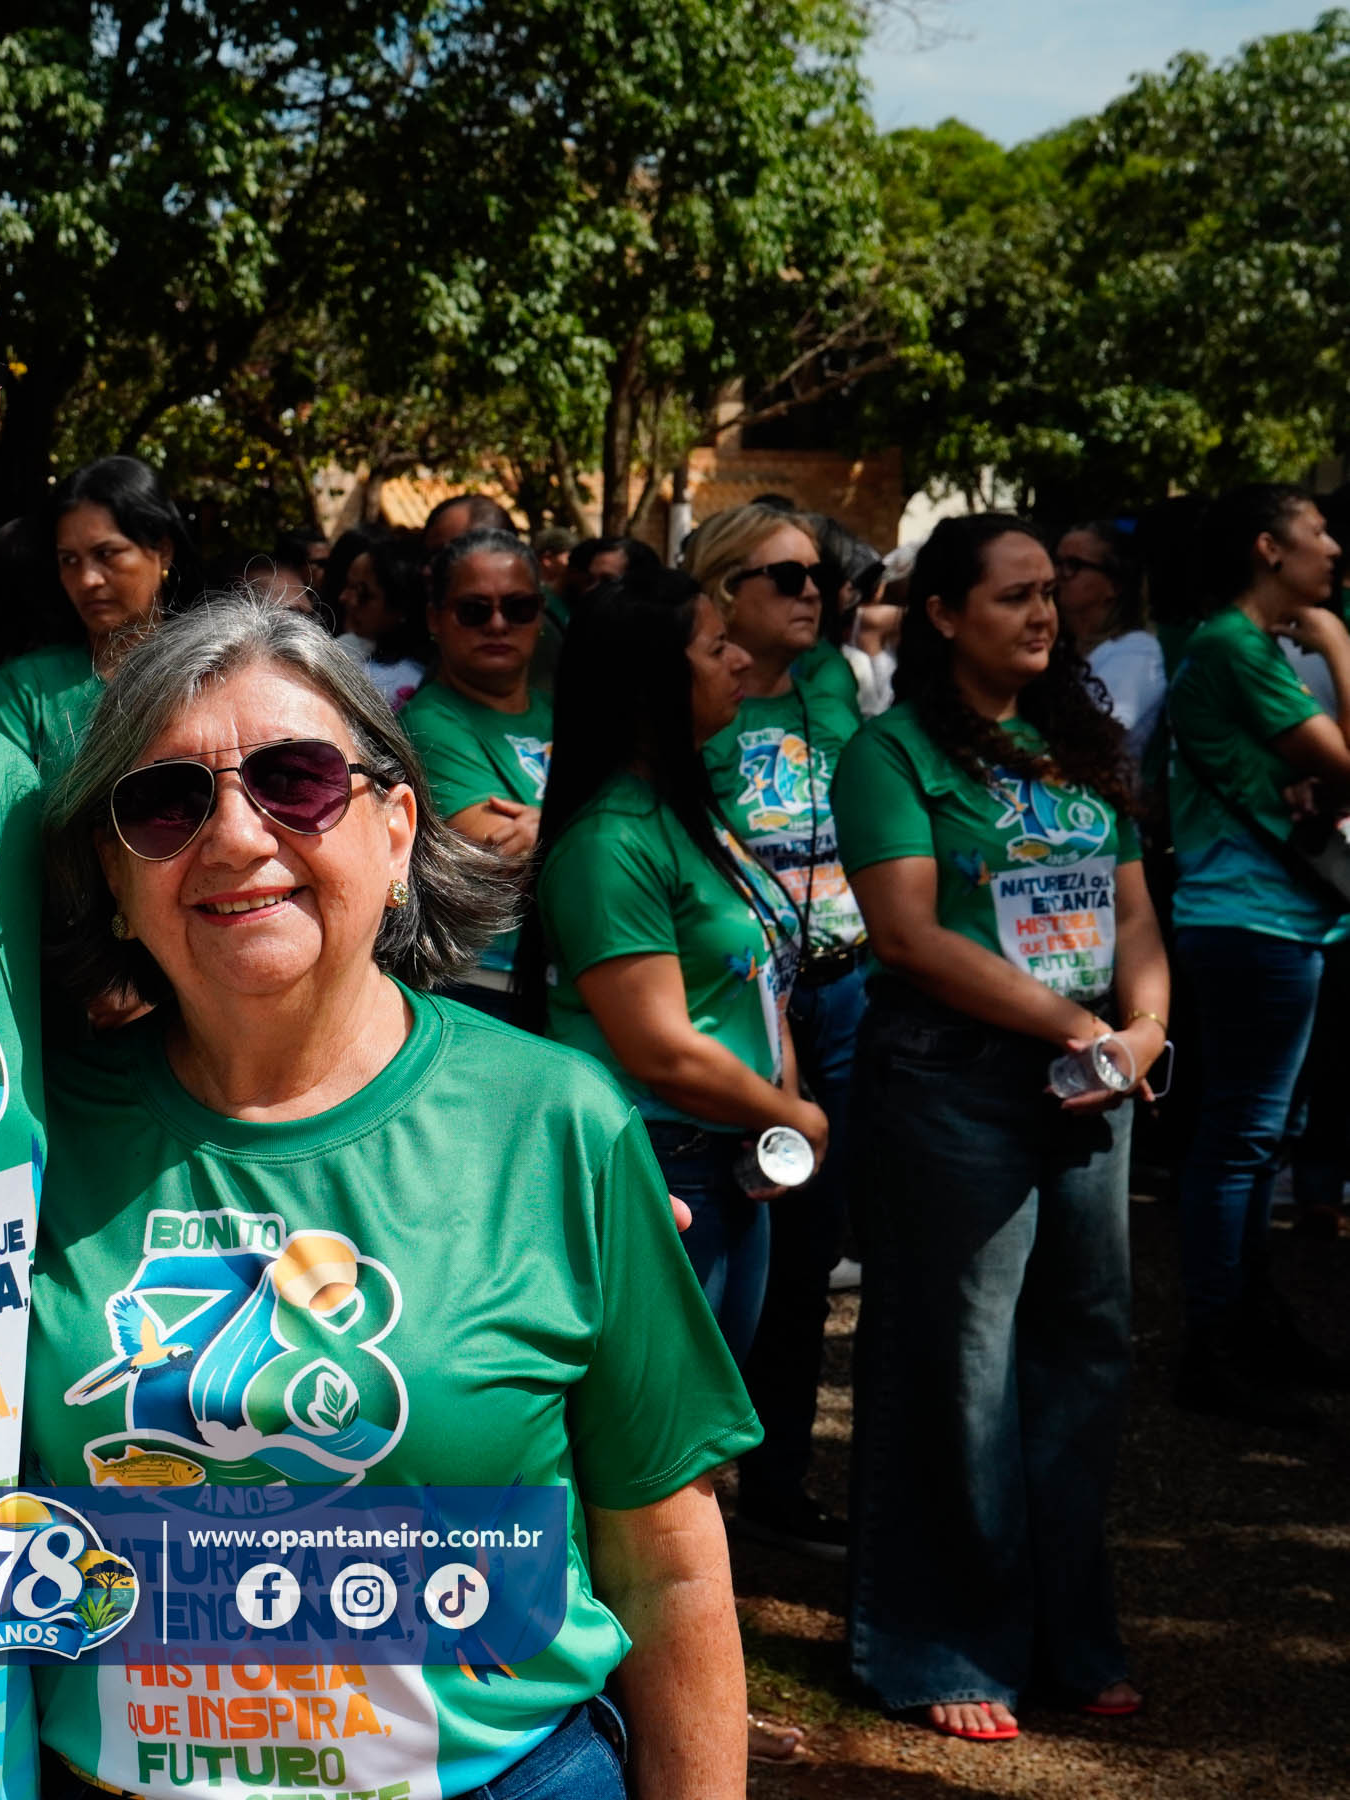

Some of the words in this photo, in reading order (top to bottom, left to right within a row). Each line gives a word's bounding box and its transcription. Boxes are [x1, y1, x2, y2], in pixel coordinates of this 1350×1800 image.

[1000, 872, 1086, 898] NATUREZA
[150, 1213, 282, 1251] BONITO
[194, 1479, 296, 1515] ANOS
[128, 1701, 182, 1737] QUE
[186, 1692, 393, 1741] INSPIRA,
[137, 1740, 347, 1788] FUTURO
